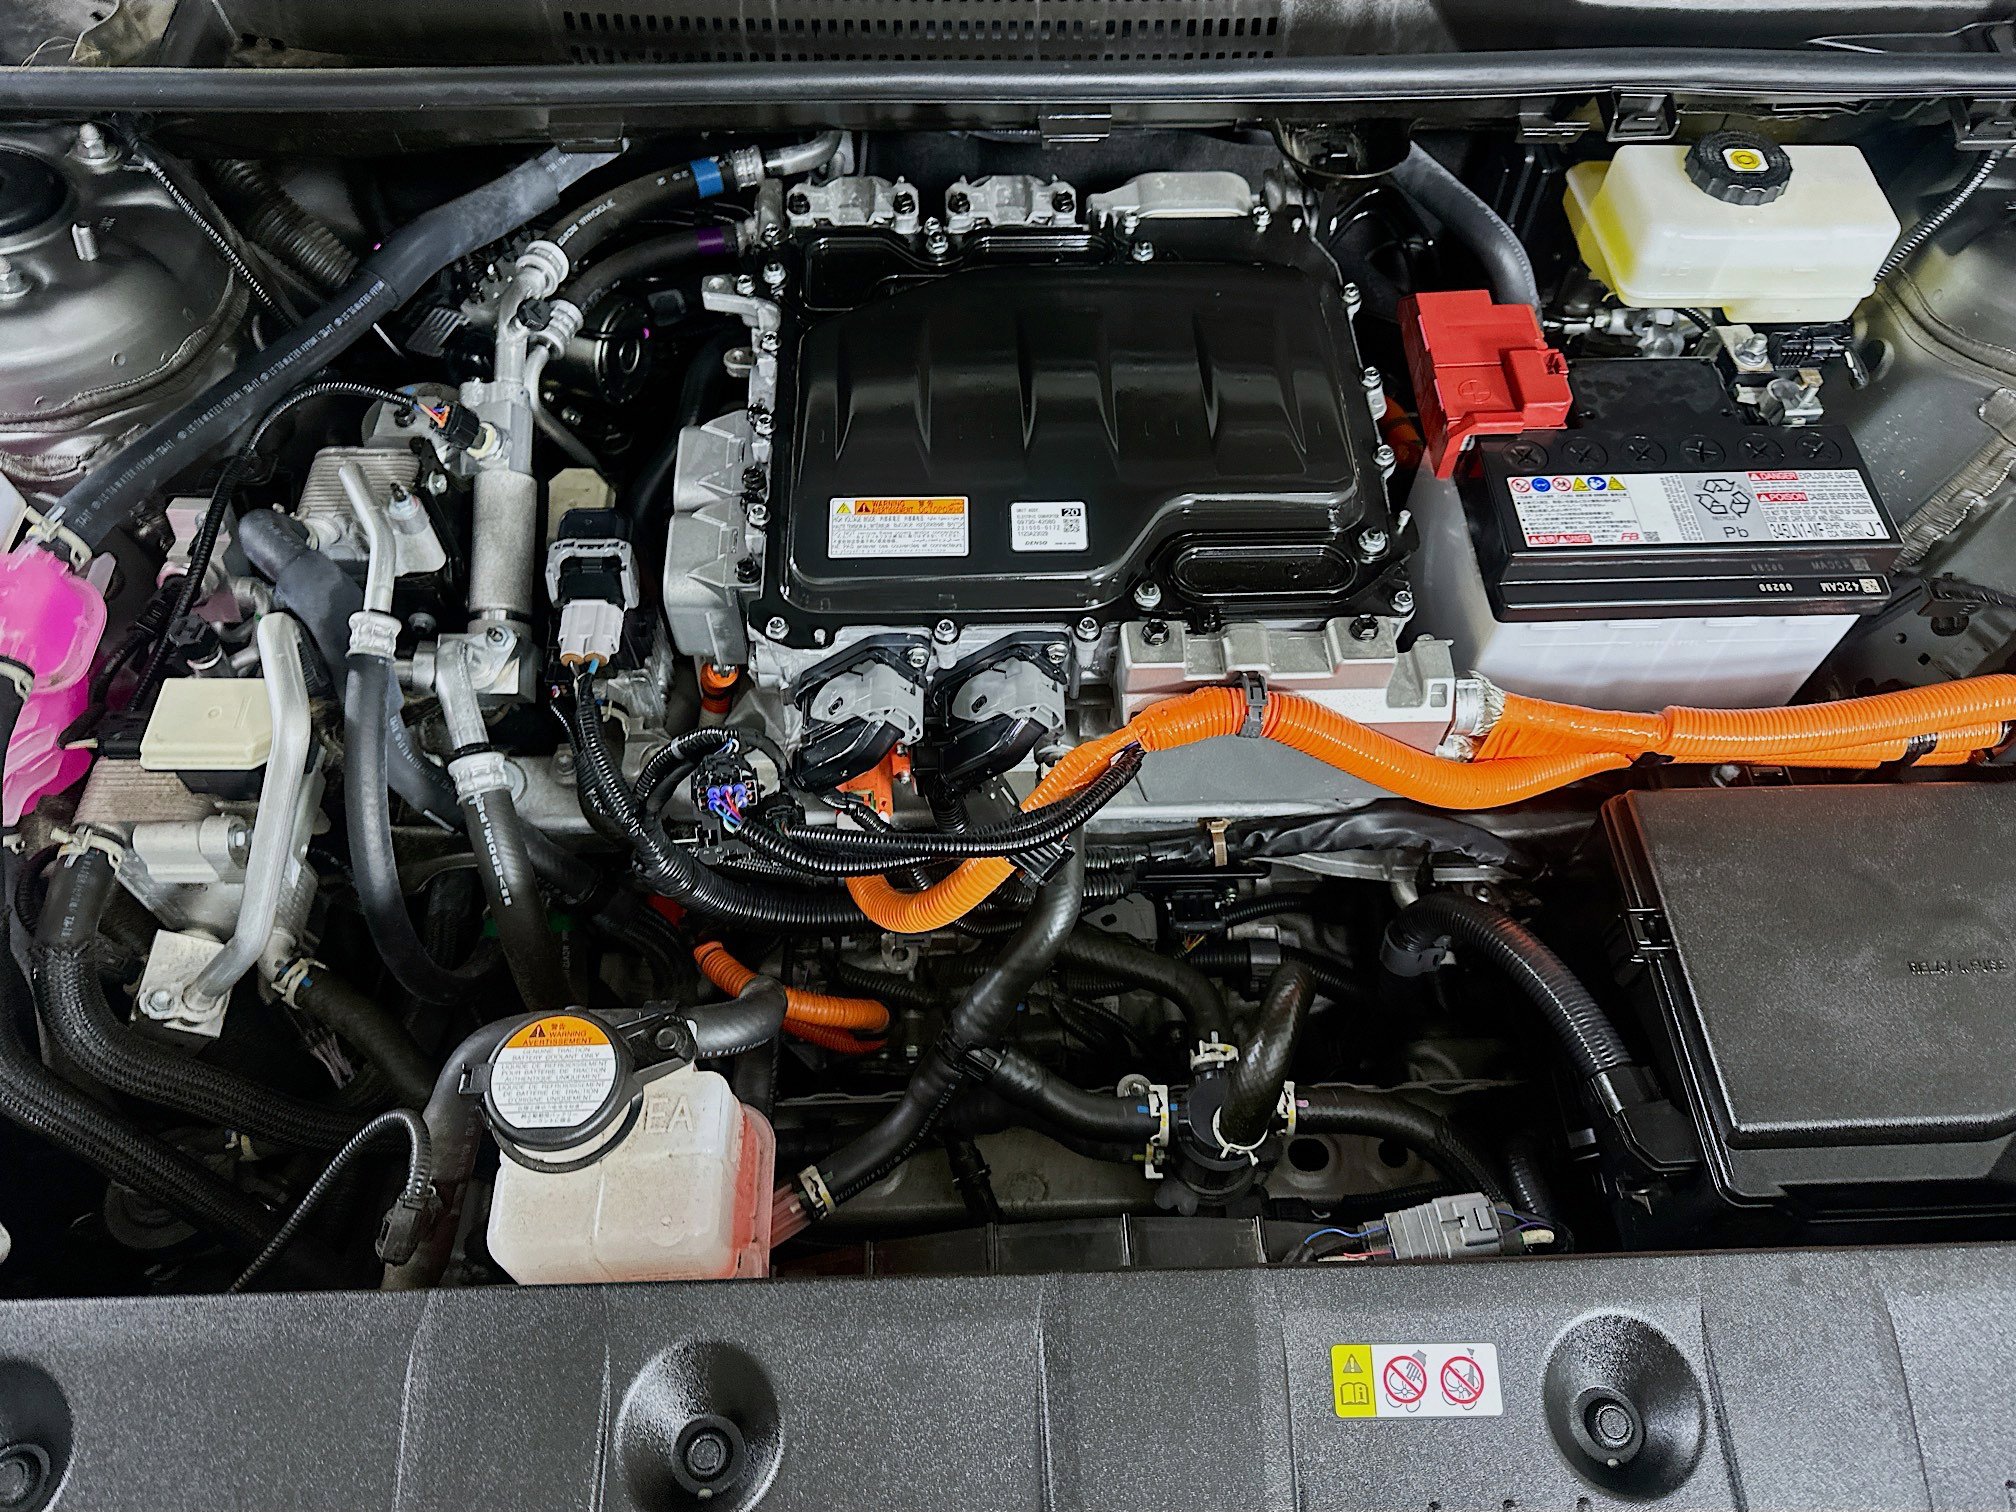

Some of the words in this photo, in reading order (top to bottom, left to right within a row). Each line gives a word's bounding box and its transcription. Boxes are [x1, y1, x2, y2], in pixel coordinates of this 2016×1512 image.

[1759, 472, 1797, 480] DANGER
[1769, 493, 1807, 501] POISON
[1063, 508, 1080, 516] 20
[1723, 526, 1749, 538] Pb
[1866, 521, 1886, 537] J1
[1820, 582, 1860, 592] 42CAM
[1907, 960, 1954, 976] RELAY
[1970, 959, 2007, 974] FUSE
[549, 1030, 587, 1038] WARNING
[522, 1038, 592, 1046] AVERTISSEMENT
